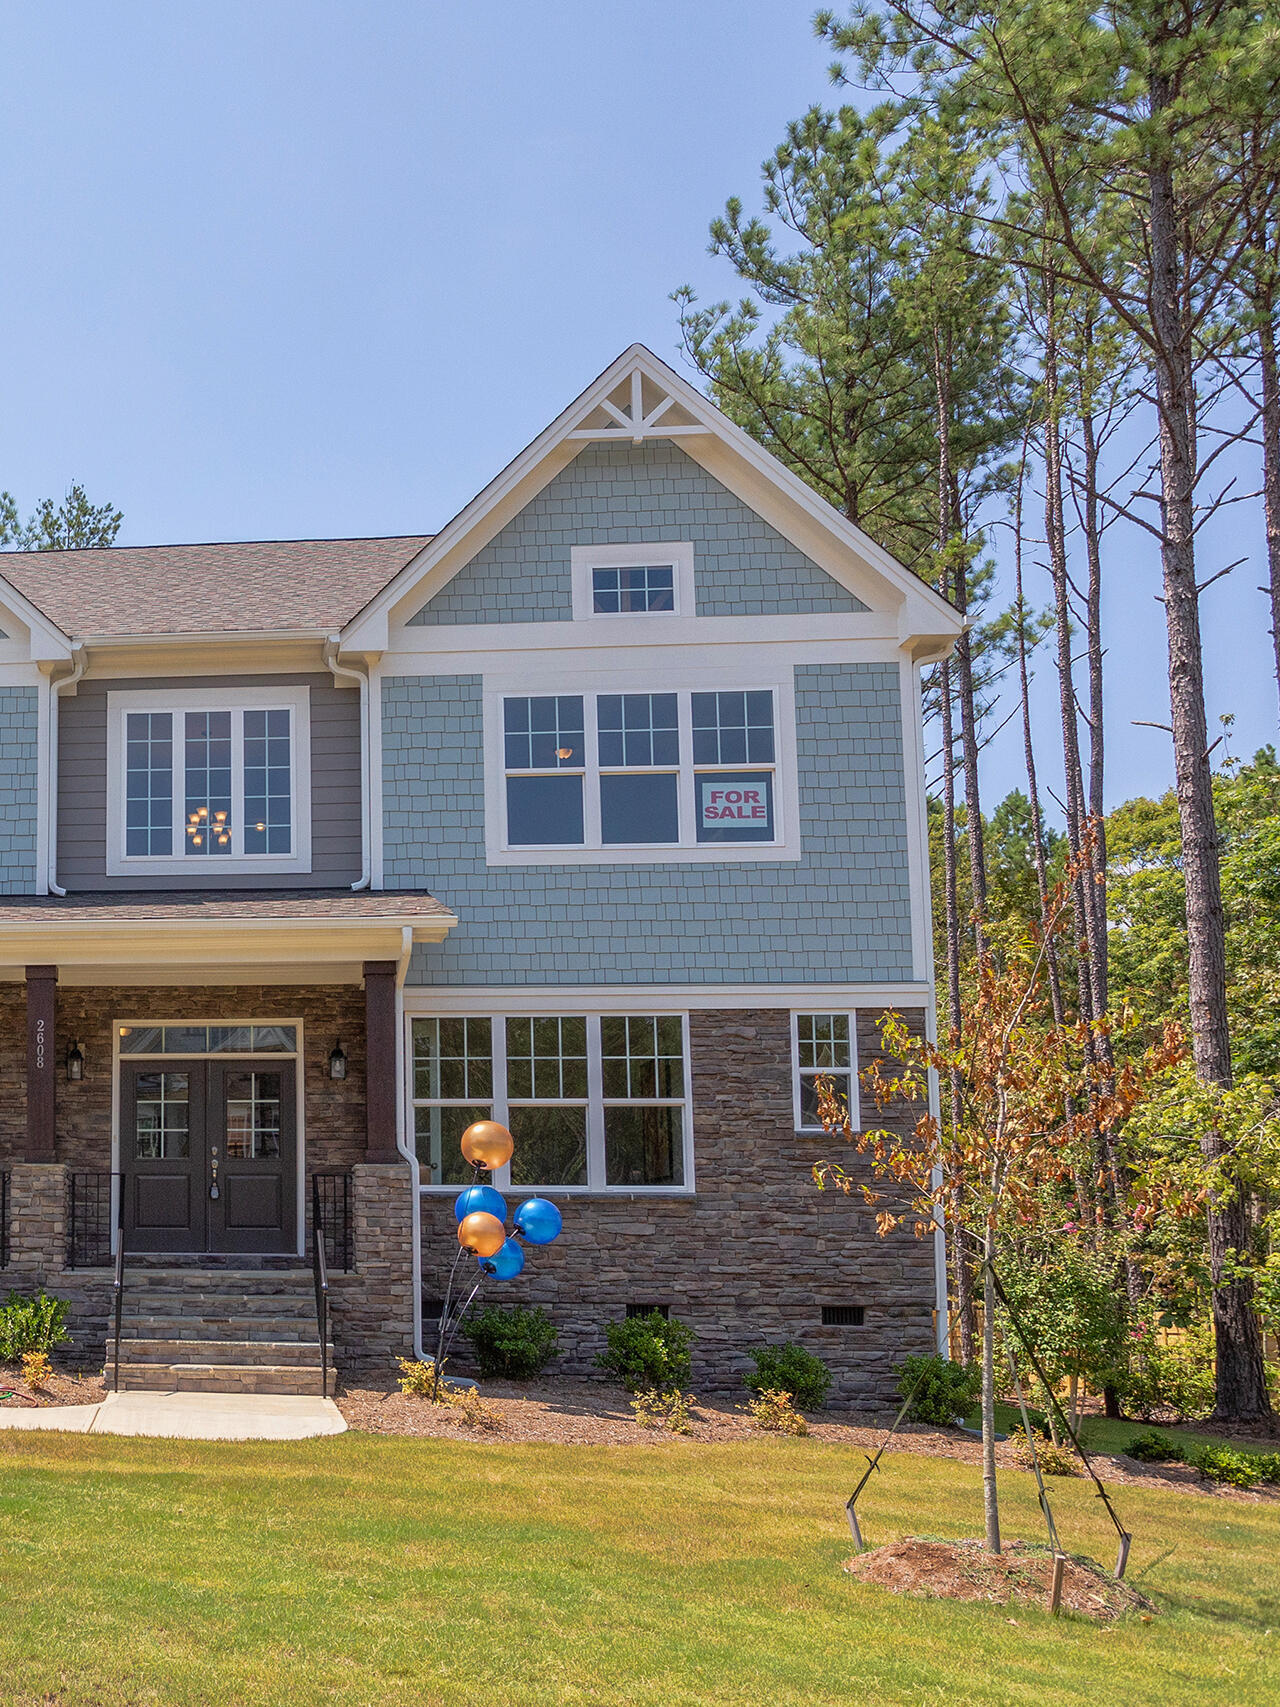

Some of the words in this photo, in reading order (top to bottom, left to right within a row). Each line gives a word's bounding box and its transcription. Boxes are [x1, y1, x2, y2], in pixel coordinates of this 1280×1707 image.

[710, 790, 761, 804] FOR
[704, 805, 766, 819] SALE
[36, 1019, 45, 1069] 2608
